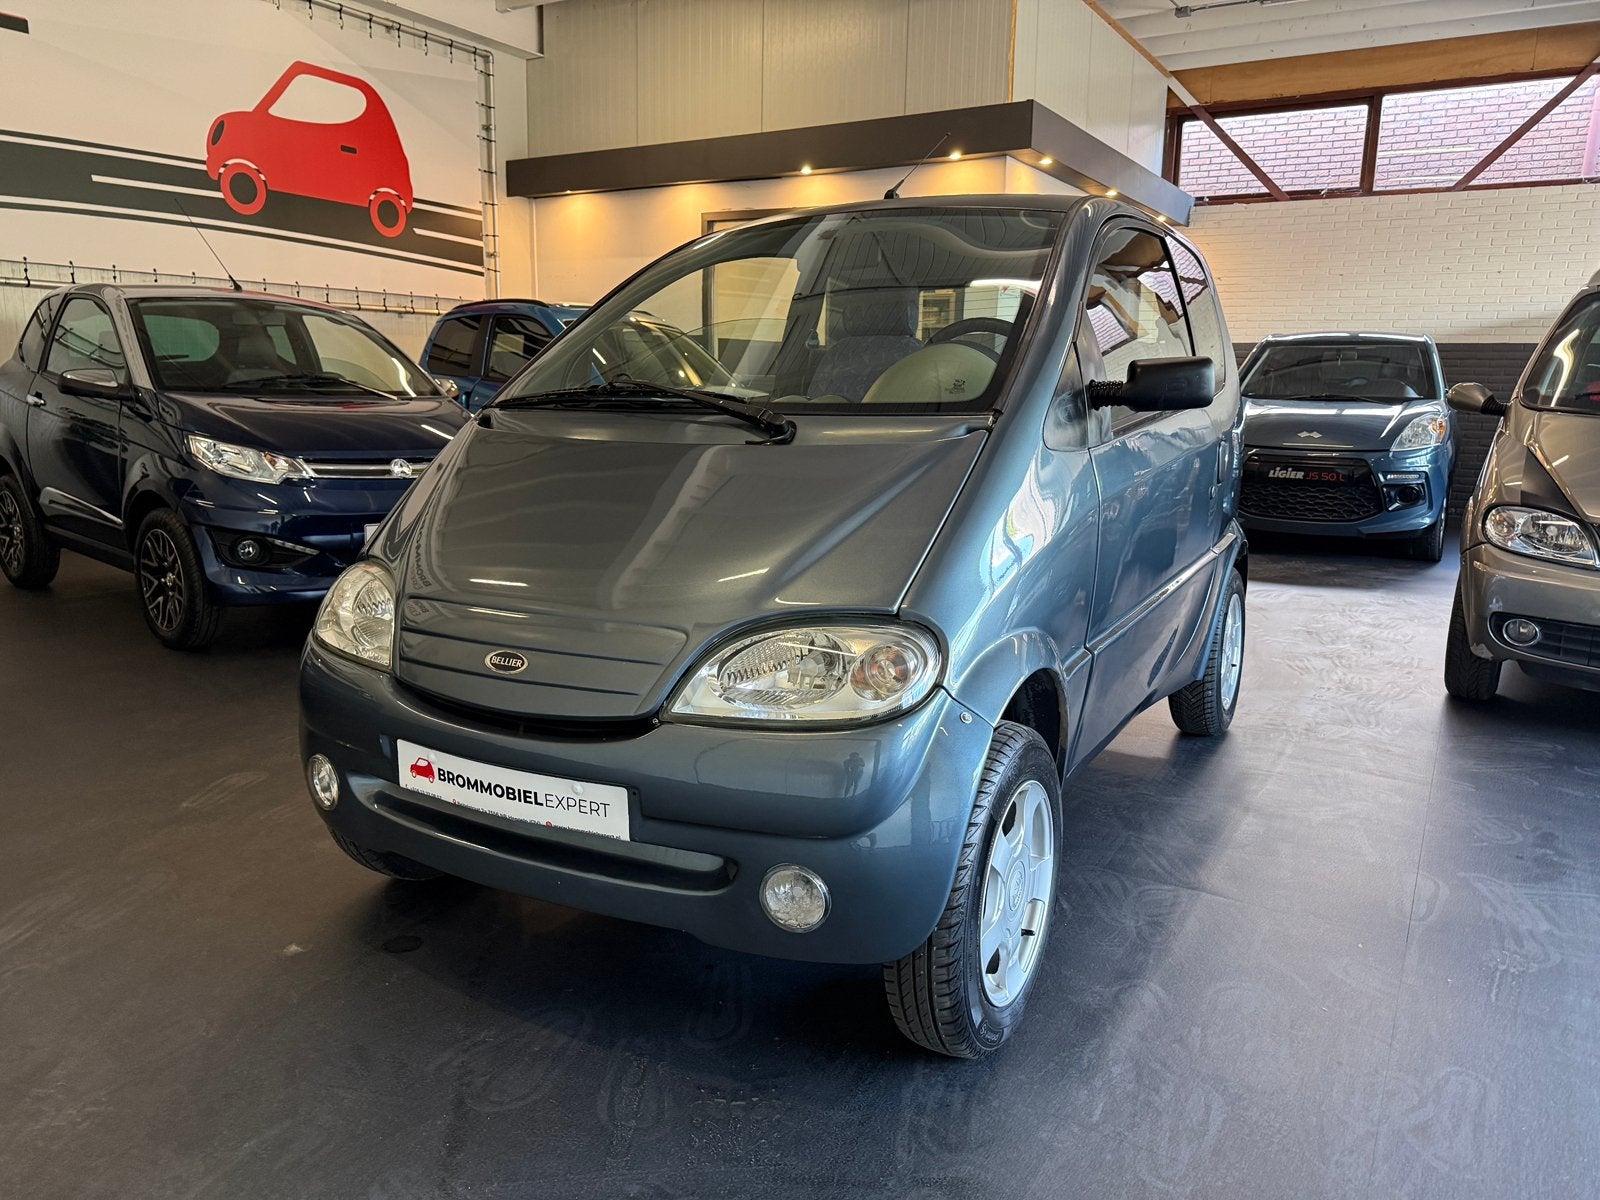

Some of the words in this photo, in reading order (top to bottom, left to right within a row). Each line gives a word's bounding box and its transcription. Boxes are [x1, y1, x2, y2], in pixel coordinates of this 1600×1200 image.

[1307, 472, 1319, 480] JS
[1322, 472, 1337, 481] 50
[491, 655, 523, 668] BELLIER
